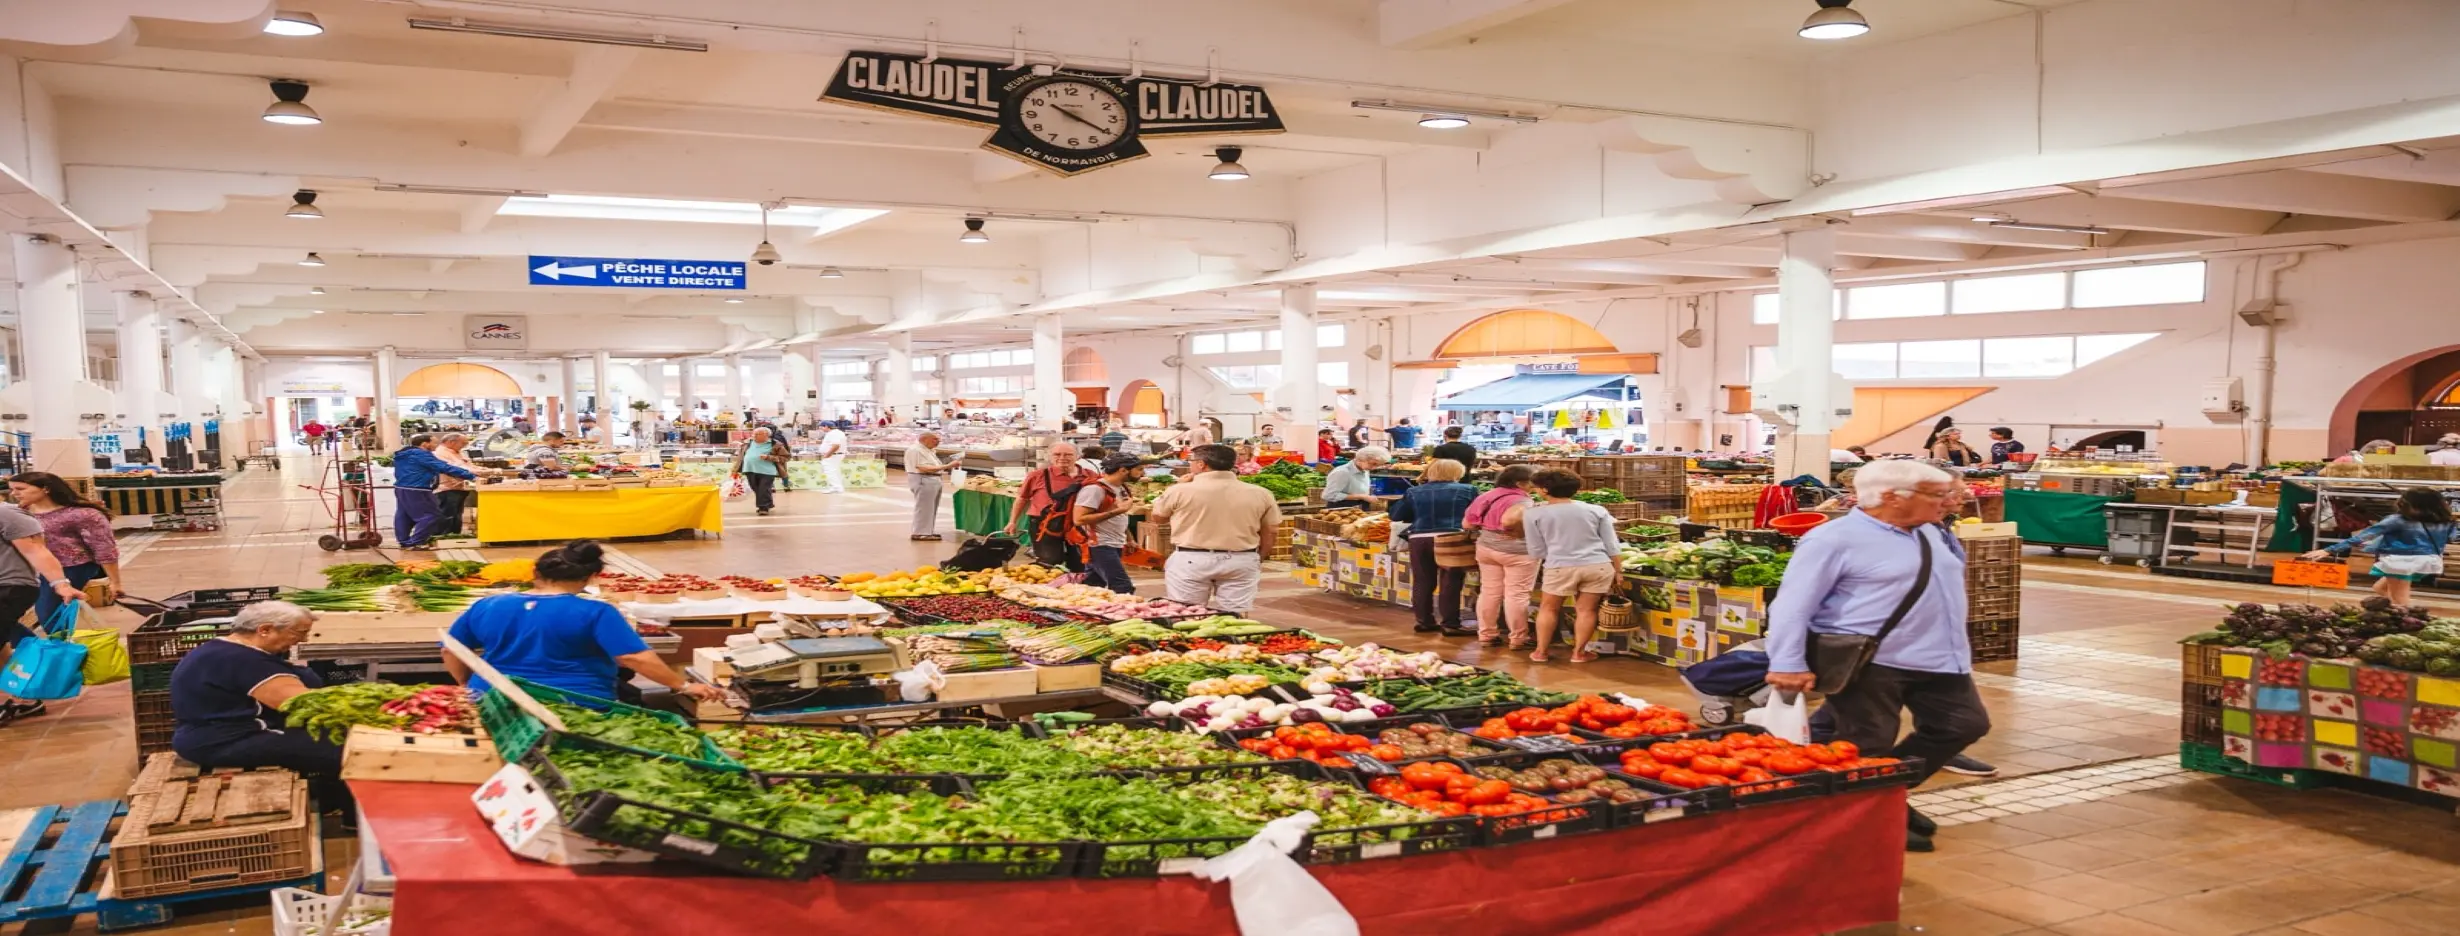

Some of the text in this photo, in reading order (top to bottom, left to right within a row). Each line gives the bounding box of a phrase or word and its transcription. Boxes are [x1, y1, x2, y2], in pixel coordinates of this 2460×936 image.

[847, 57, 1000, 108] CLAUDEL
[1047, 90, 1058, 98] 11
[1064, 87, 1079, 96] 12
[1031, 98, 1044, 107] 10
[1138, 82, 1268, 120] CLAUDEL
[1101, 102, 1111, 110] 2
[1026, 110, 1038, 118] 9
[1107, 115, 1118, 123] 3
[1032, 123, 1043, 131] 8
[1048, 133, 1058, 141] 7
[1067, 137, 1079, 146] 6
[1088, 135, 1098, 144] 5
[1023, 147, 1118, 165] DE NORMANDIE
[601, 262, 743, 276] PÊCHE LOCALE
[611, 275, 734, 286] VENTE DIRECTE
[471, 331, 521, 339] CANNES
